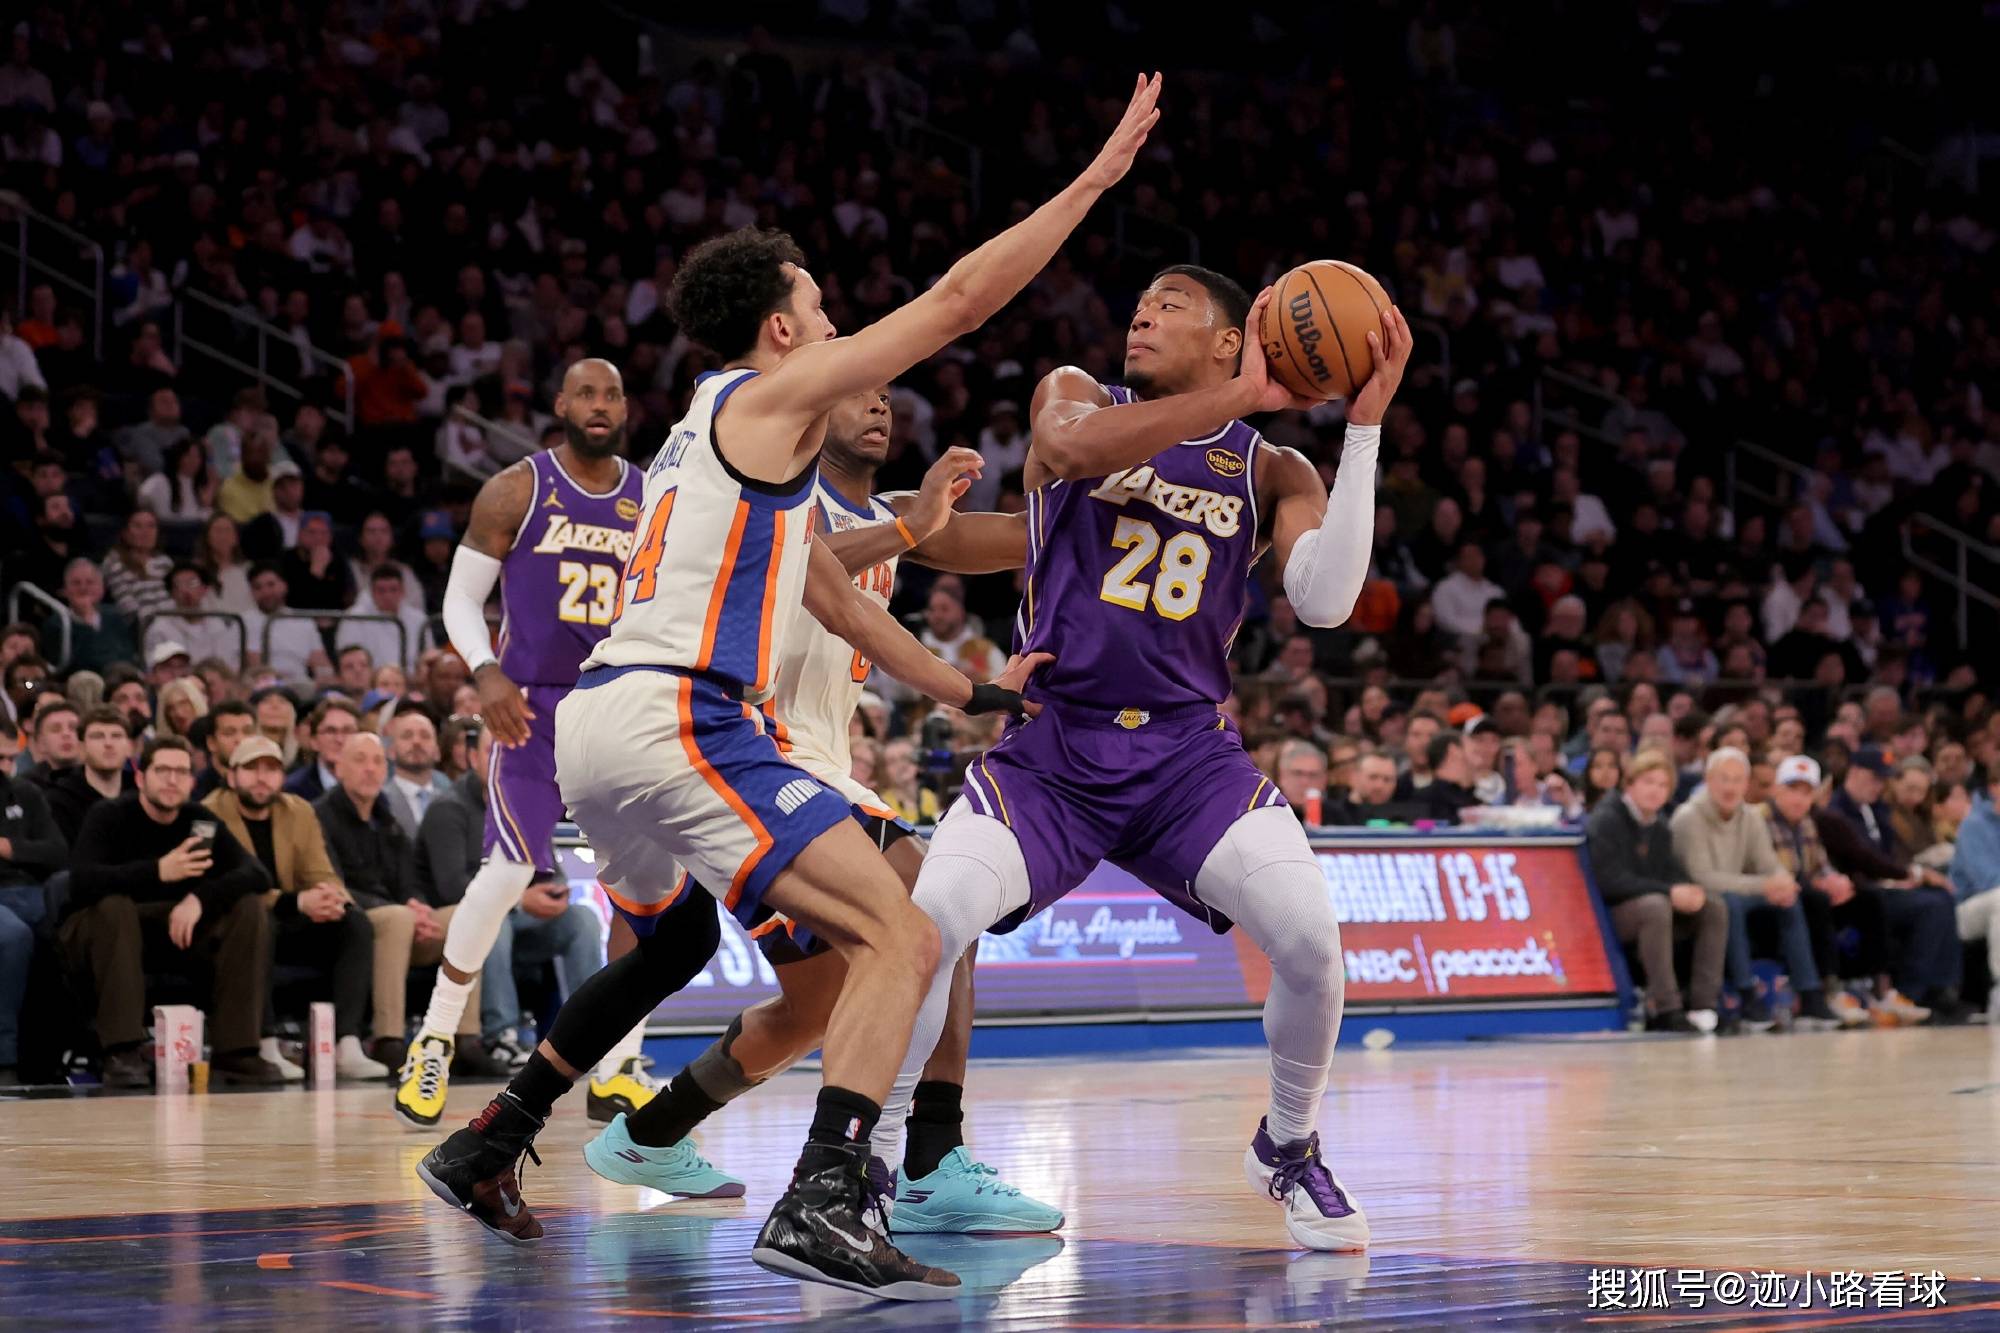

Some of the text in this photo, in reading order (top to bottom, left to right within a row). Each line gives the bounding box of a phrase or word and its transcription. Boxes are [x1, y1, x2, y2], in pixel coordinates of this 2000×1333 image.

[1290, 291, 1332, 382] Wilson
[1209, 452, 1243, 471] bibigo
[1088, 462, 1245, 538] LAKERS
[533, 515, 634, 562] LAKERS
[1099, 515, 1212, 622] 28
[559, 560, 618, 627] 23
[1440, 852, 1531, 922] 13-15
[1037, 905, 1183, 959] Los Angeles
[1344, 936, 1553, 994] NBC peacock
